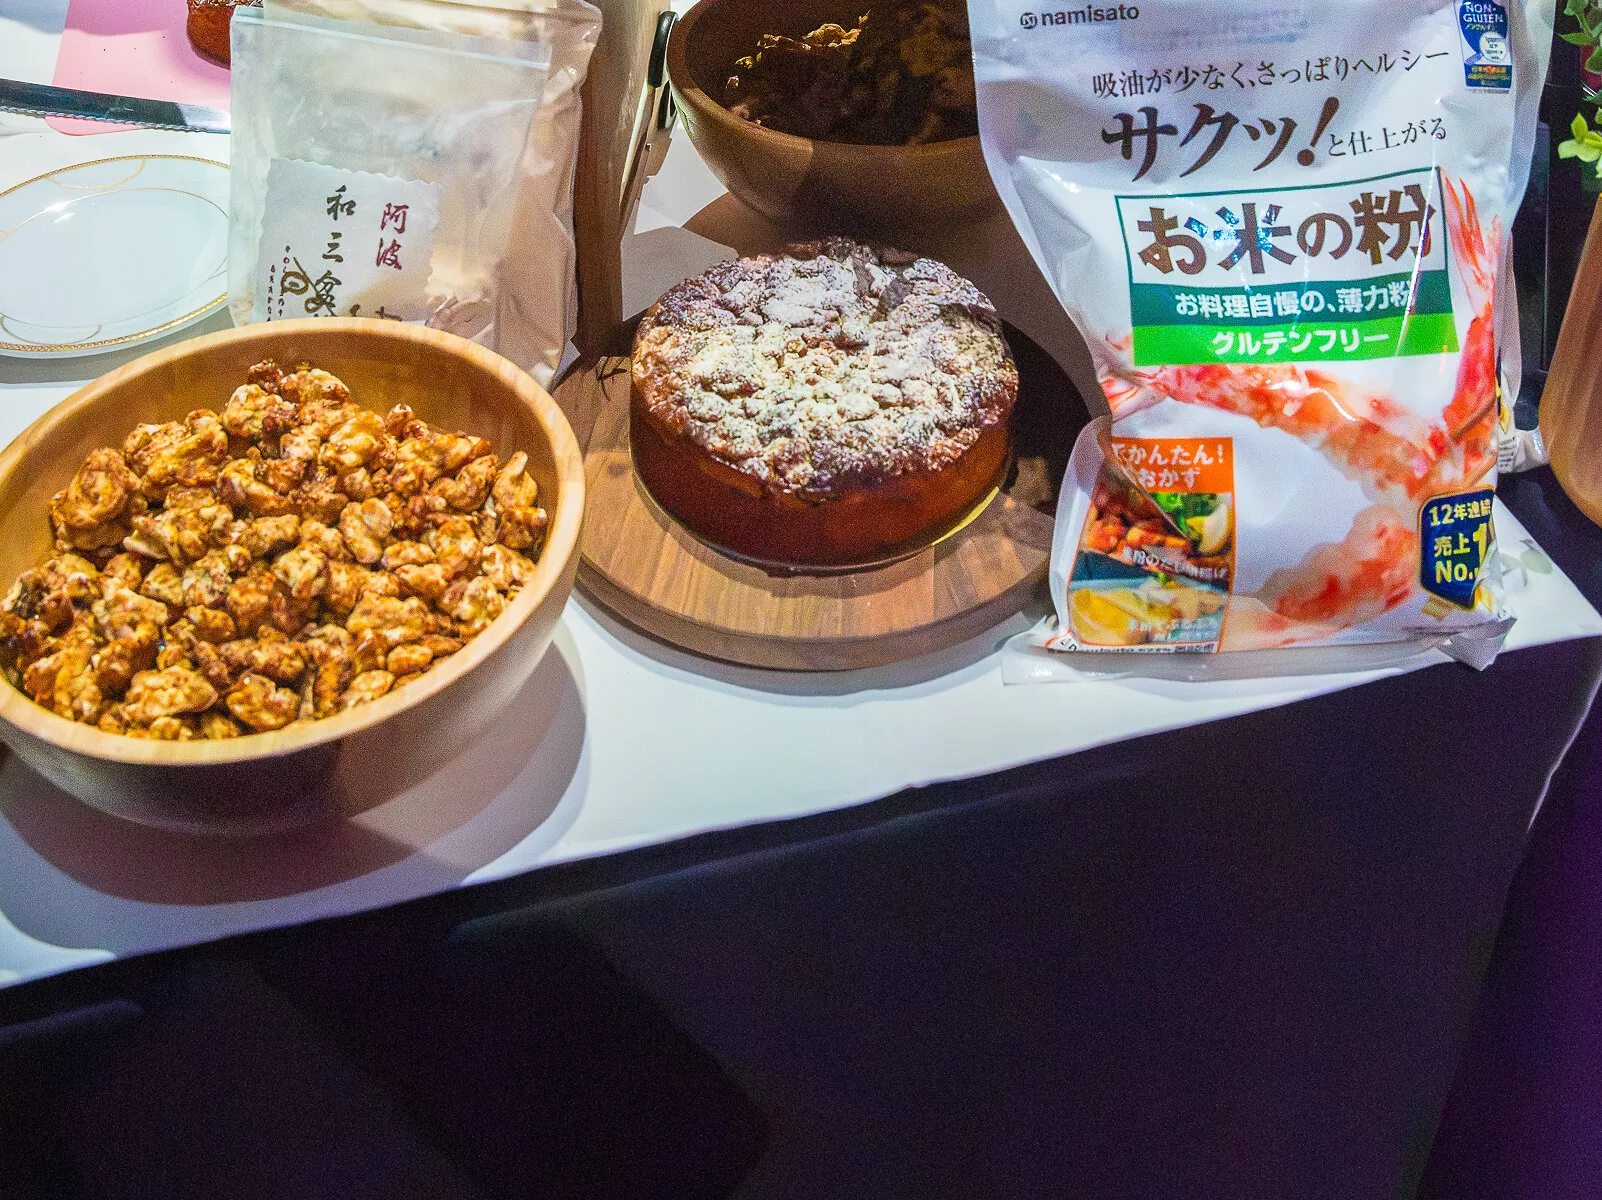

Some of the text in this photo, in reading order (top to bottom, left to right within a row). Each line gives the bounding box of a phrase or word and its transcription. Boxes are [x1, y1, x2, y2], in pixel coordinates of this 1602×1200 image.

[1041, 4, 1140, 26] namisato
[1462, 12, 1504, 23] GLUTEN
[376, 202, 409, 271] 阿波
[1137, 184, 1436, 275] お米の粉
[1211, 327, 1390, 356] グルテンフリー
[1434, 532, 1470, 557] 売上
